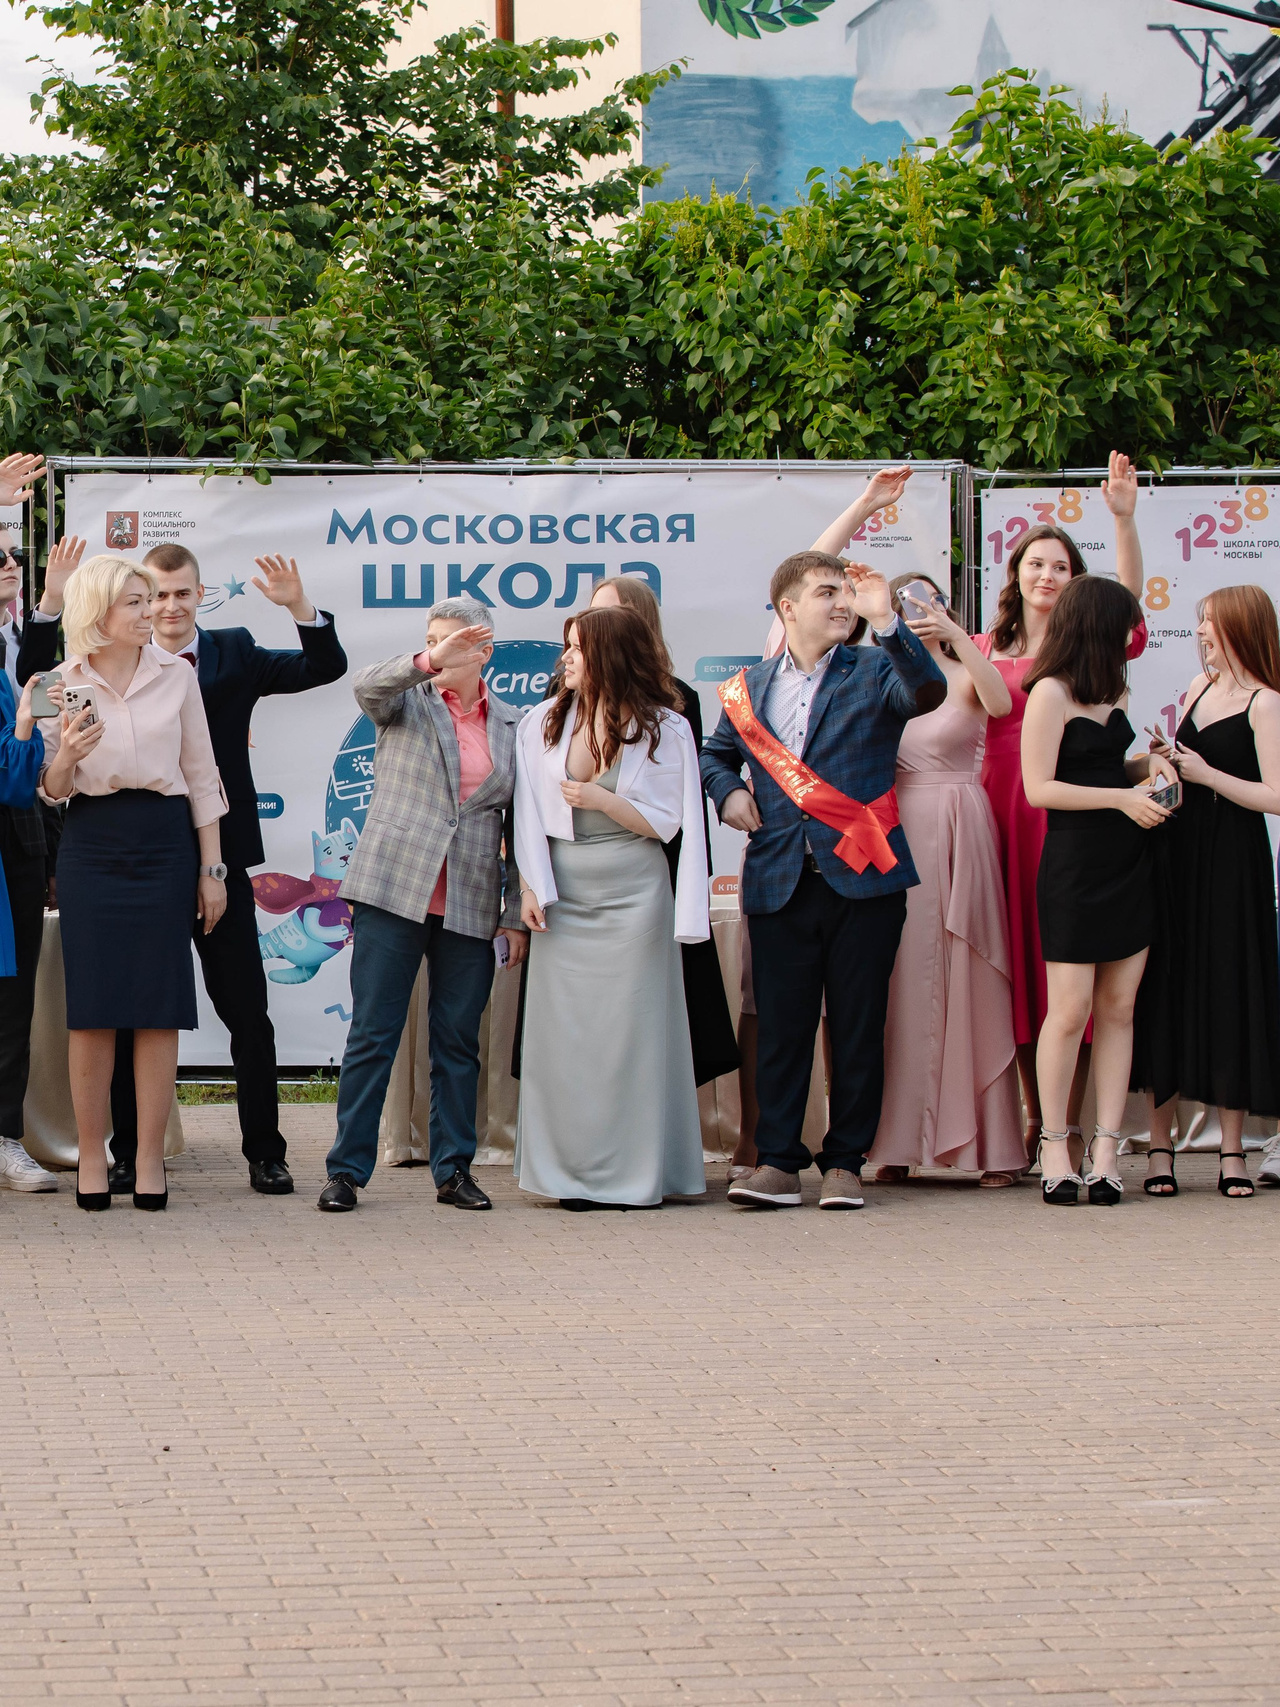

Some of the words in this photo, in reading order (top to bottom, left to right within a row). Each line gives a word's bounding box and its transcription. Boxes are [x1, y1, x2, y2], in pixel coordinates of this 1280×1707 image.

[326, 507, 696, 545] Московская
[1175, 487, 1269, 562] 1238
[1223, 540, 1256, 548] ШКОЛА
[1257, 540, 1280, 548] ГОРО
[1223, 551, 1263, 559] МОСКВЫ
[1157, 630, 1193, 638] ГОРОДА
[703, 665, 727, 673] ЕСТЬ
[256, 802, 277, 810] ЕКИ!
